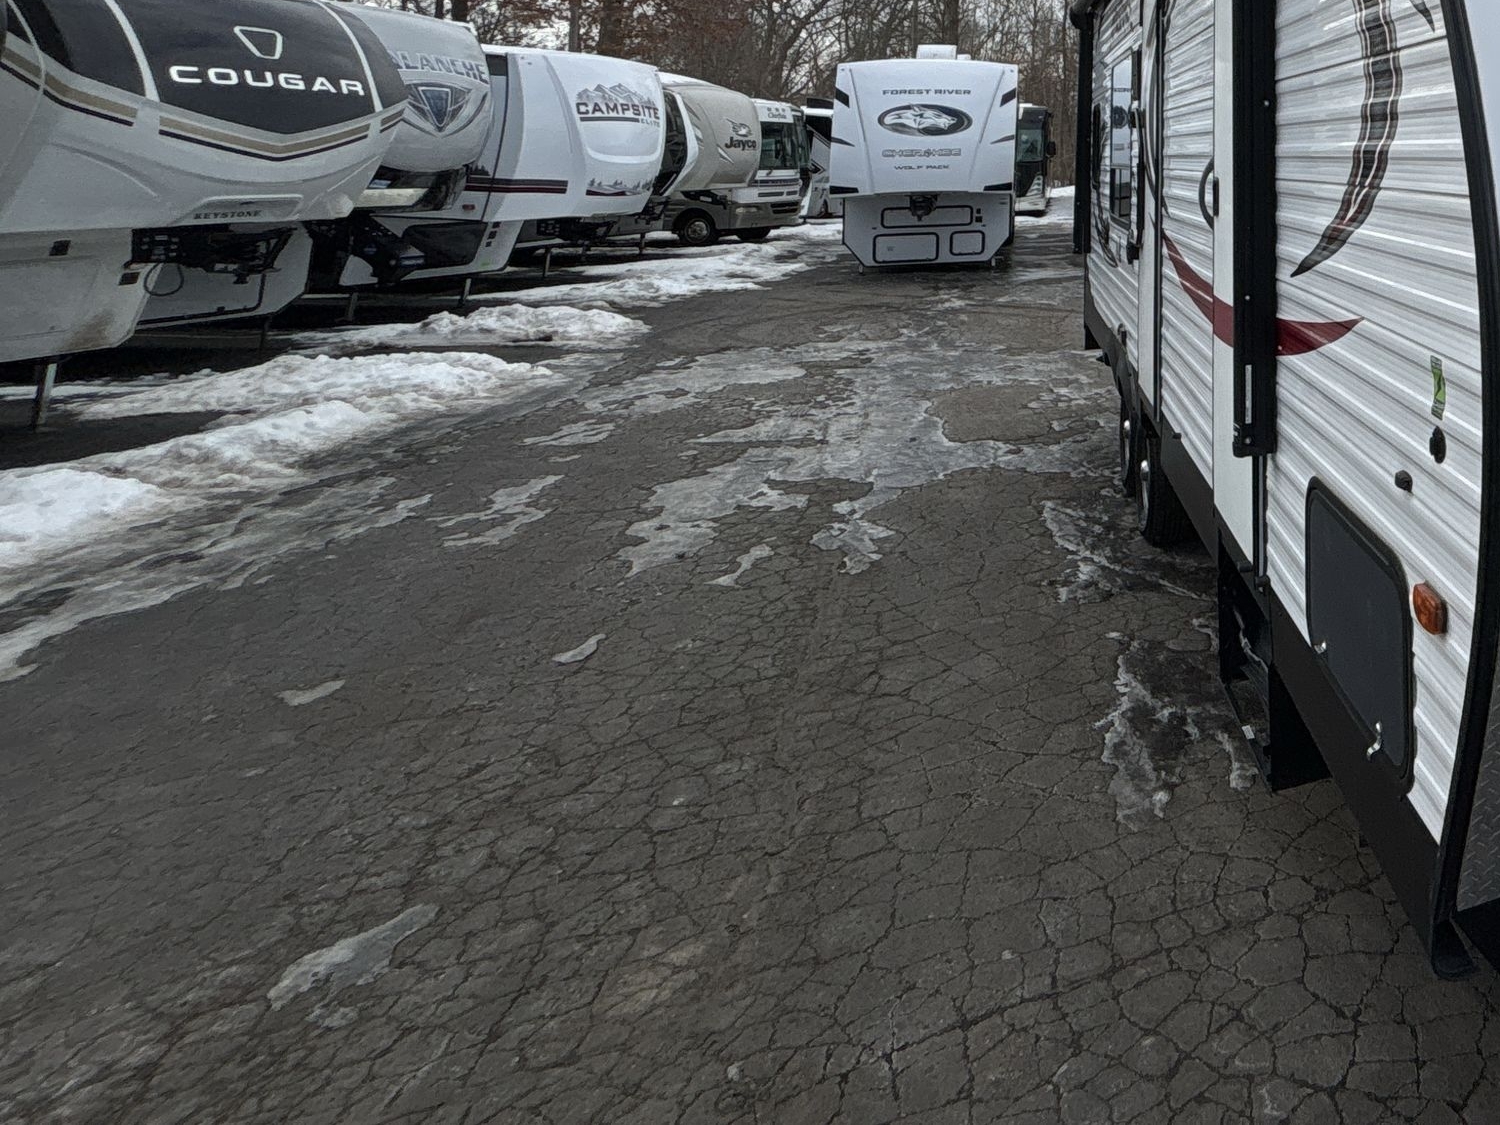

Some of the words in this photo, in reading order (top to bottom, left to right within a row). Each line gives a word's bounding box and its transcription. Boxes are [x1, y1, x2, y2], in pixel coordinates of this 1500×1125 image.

[169, 65, 365, 96] COUGAR
[575, 101, 660, 120] CAMPSITE
[724, 136, 757, 151] Jayco
[193, 210, 262, 220] KEYSTONE
